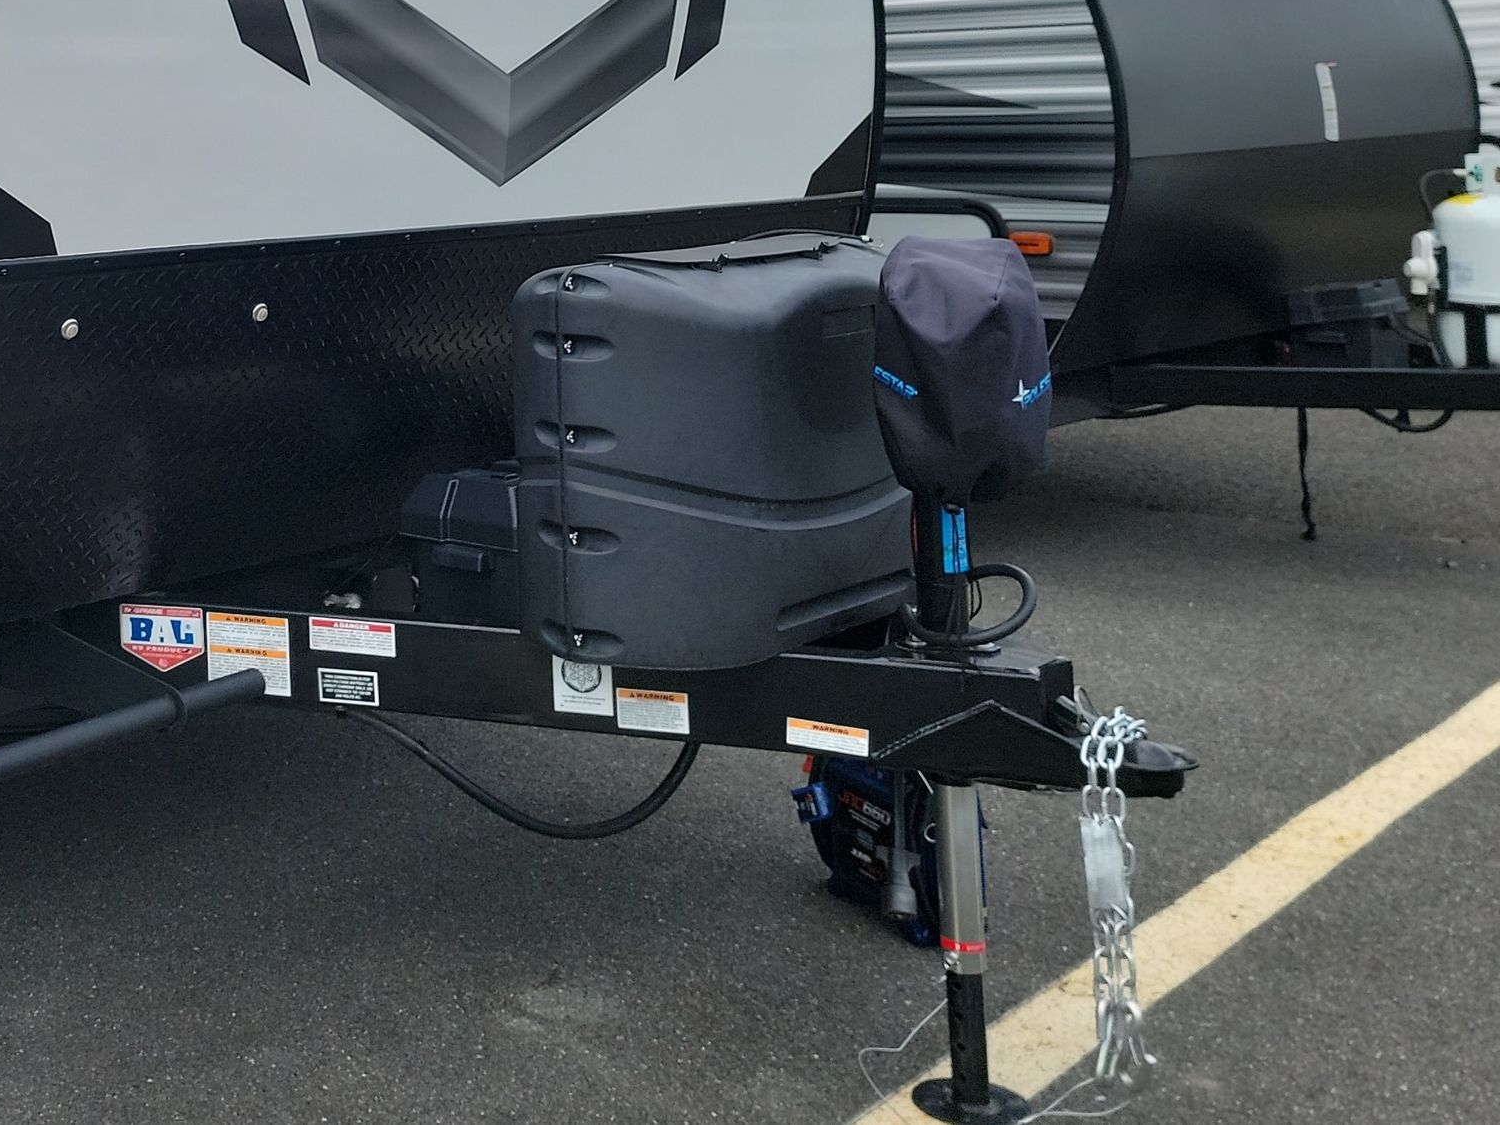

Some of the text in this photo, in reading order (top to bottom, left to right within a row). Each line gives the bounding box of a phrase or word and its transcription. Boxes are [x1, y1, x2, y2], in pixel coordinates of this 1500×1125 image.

[233, 616, 267, 625] WARNING
[129, 617, 194, 645] BAL
[234, 647, 268, 656] WARNING
[636, 693, 675, 702] WARNING
[812, 724, 849, 735] WARNING
